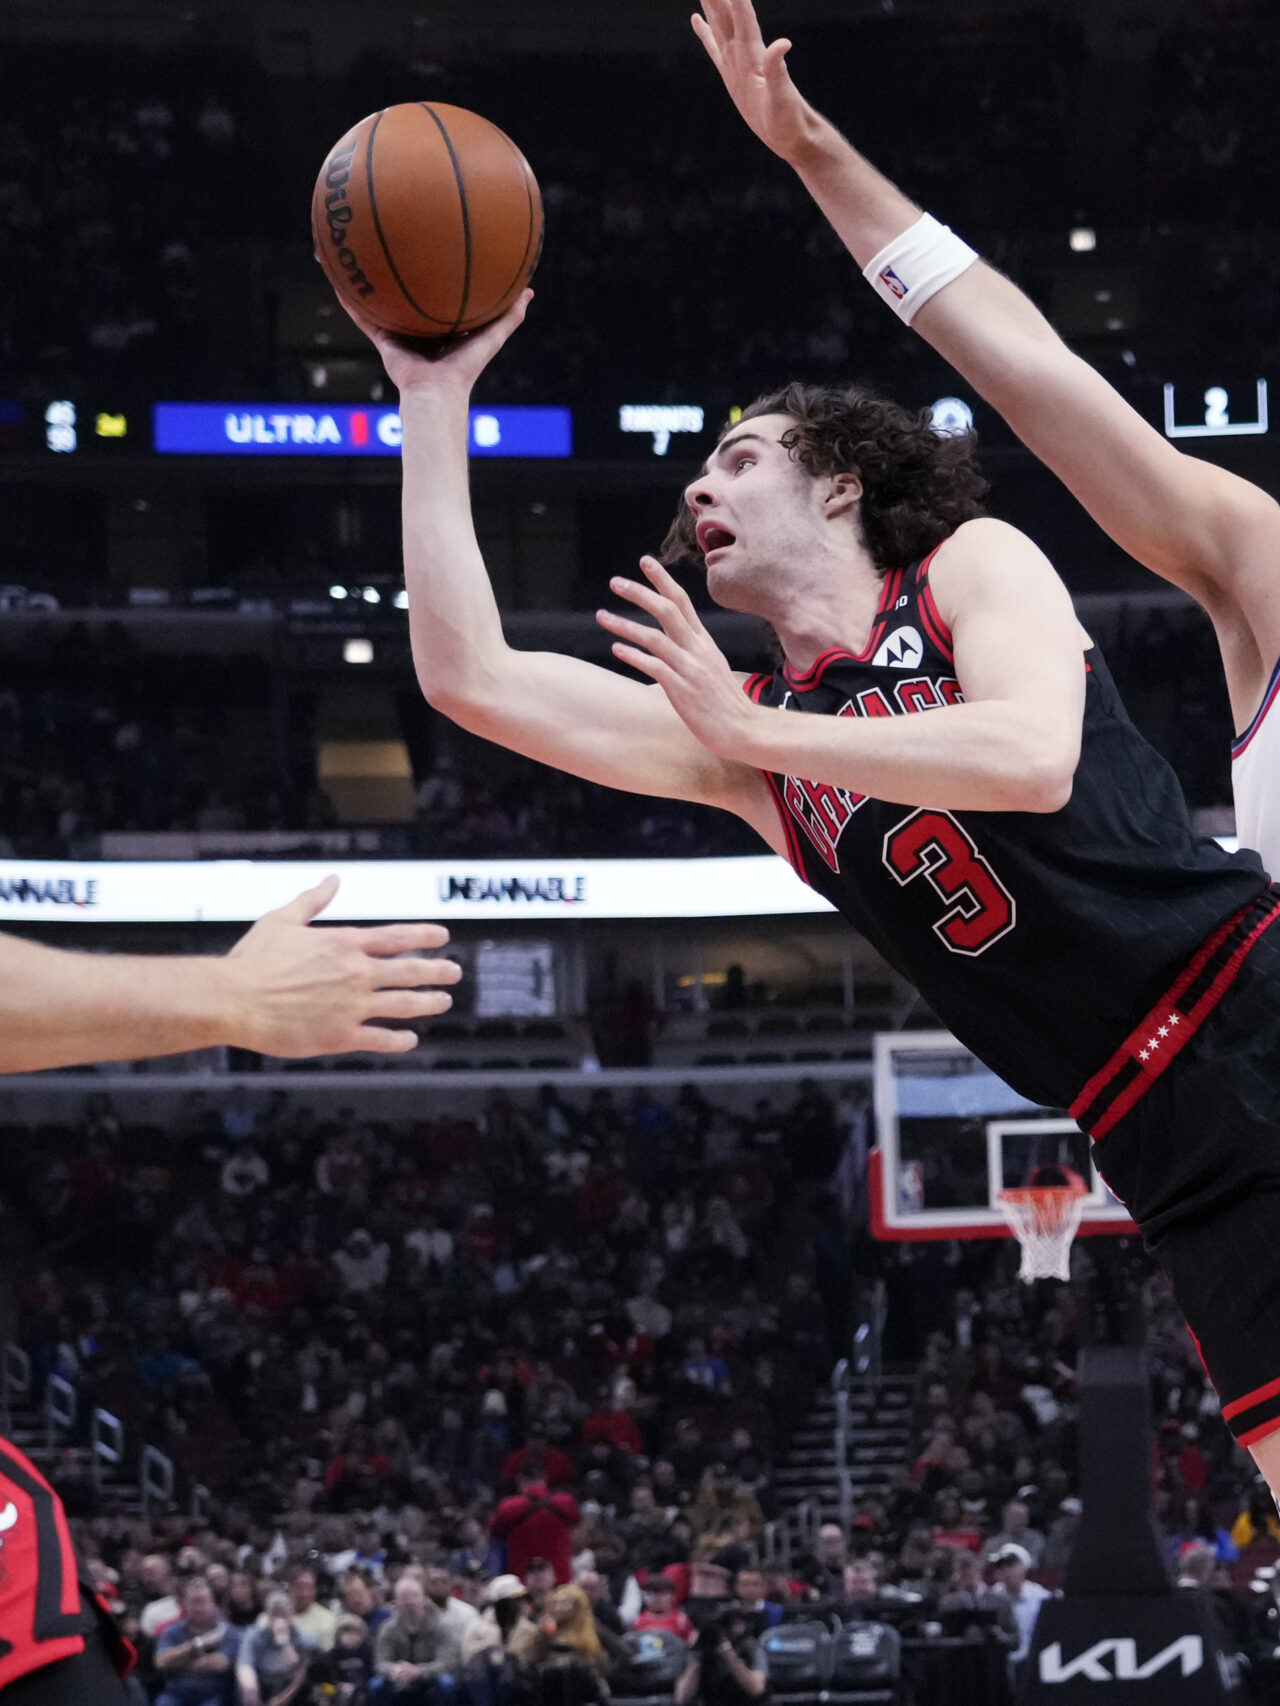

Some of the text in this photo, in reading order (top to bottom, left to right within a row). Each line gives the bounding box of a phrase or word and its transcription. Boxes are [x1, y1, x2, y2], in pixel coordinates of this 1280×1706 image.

[225, 412, 501, 448] ULTRA CB
[881, 806, 1016, 957] 3
[1039, 1634, 1204, 1684] KIA
